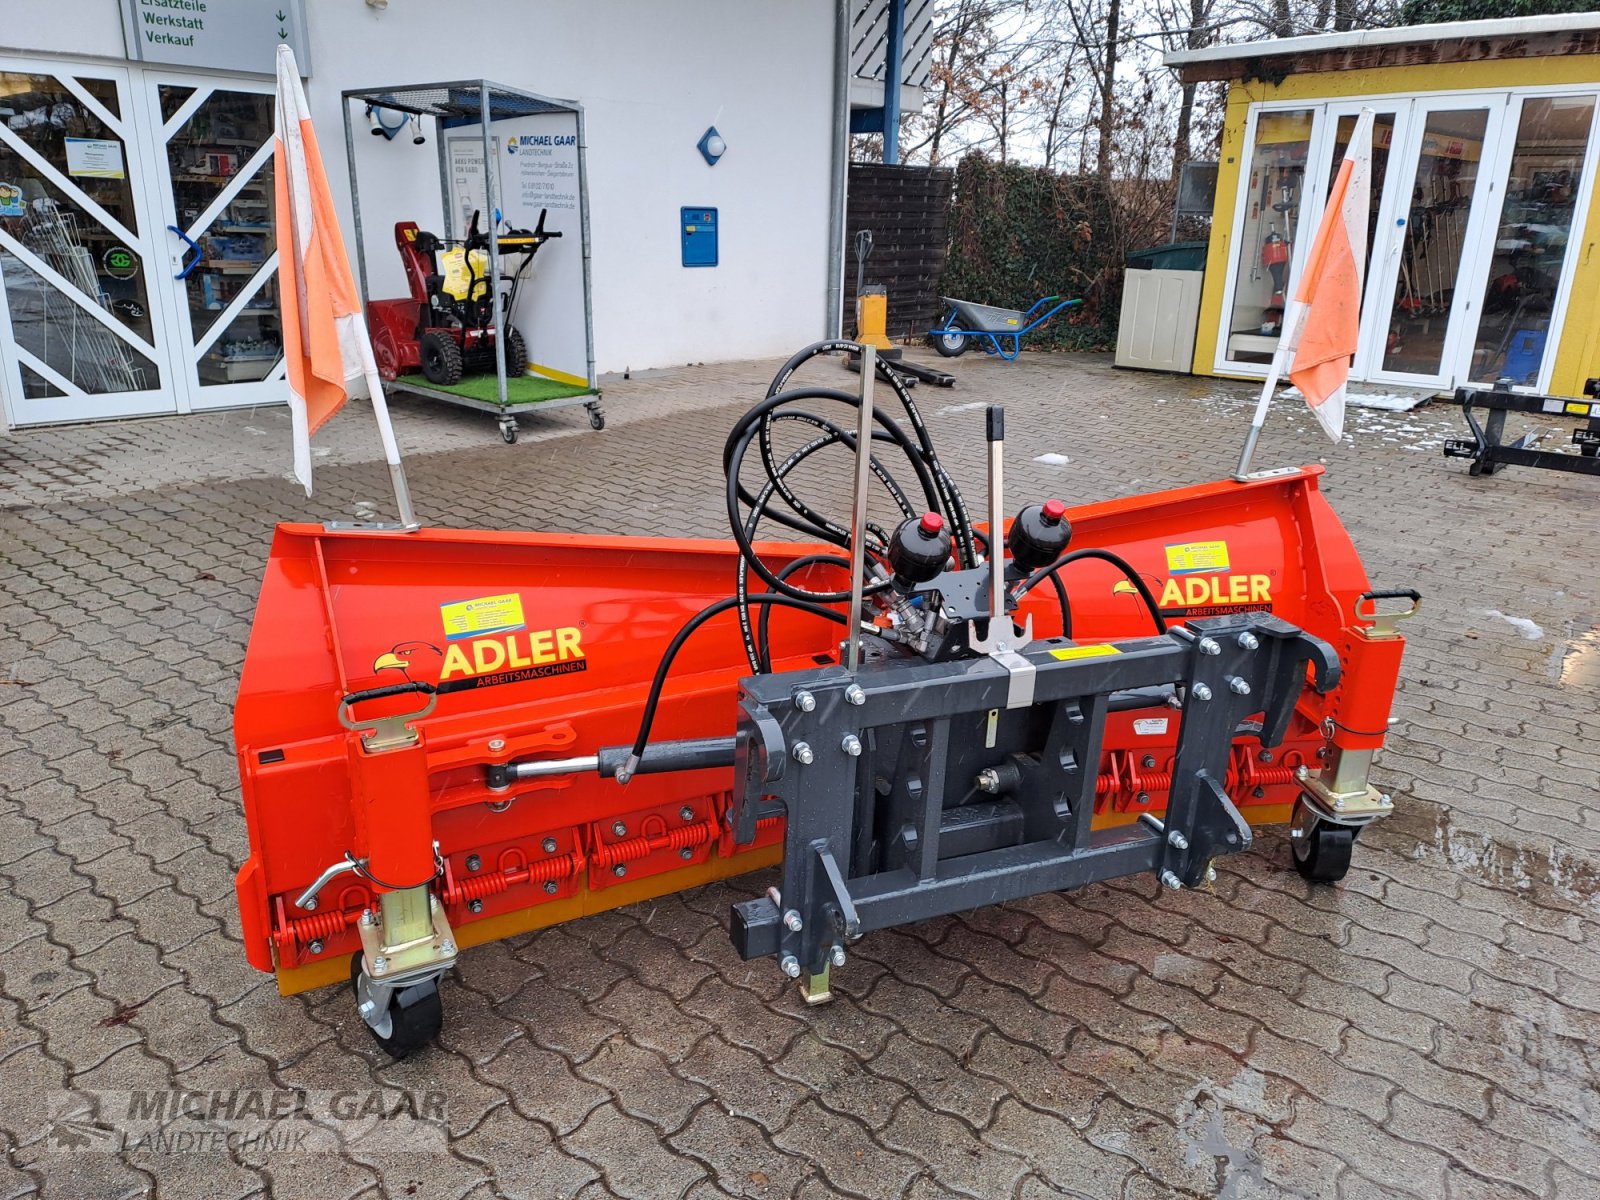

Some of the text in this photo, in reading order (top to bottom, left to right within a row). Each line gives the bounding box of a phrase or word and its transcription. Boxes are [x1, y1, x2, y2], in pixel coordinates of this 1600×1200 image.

[143, 12, 204, 30] Werkstatt
[145, 30, 194, 47] Verkauf
[520, 135, 576, 146] MICHAEL GAAR
[1160, 574, 1273, 607] ADLER
[1186, 604, 1272, 616] ARBEITSMASCHINEN
[439, 626, 585, 680] ADLER
[476, 662, 585, 687] ARBEITSMASCHINEN
